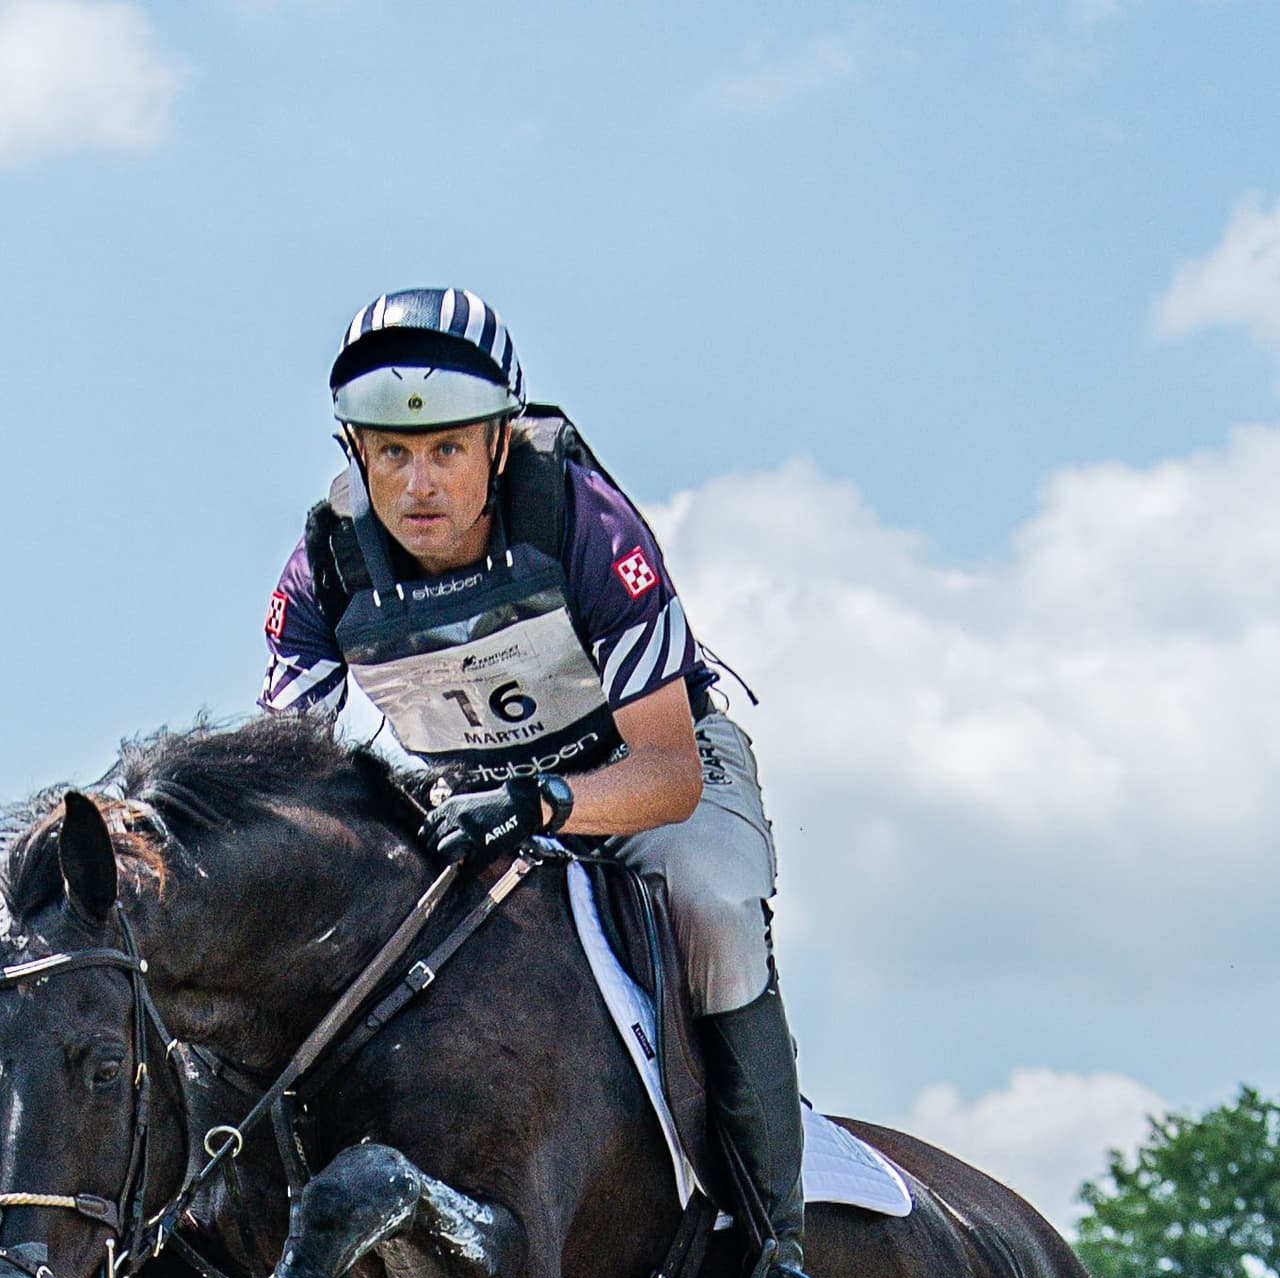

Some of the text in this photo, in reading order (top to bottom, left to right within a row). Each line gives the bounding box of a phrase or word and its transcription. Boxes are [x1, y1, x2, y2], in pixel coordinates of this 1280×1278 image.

[442, 680, 537, 728] 16
[464, 721, 545, 745] MARTIN
[485, 815, 519, 846] ARIAT
